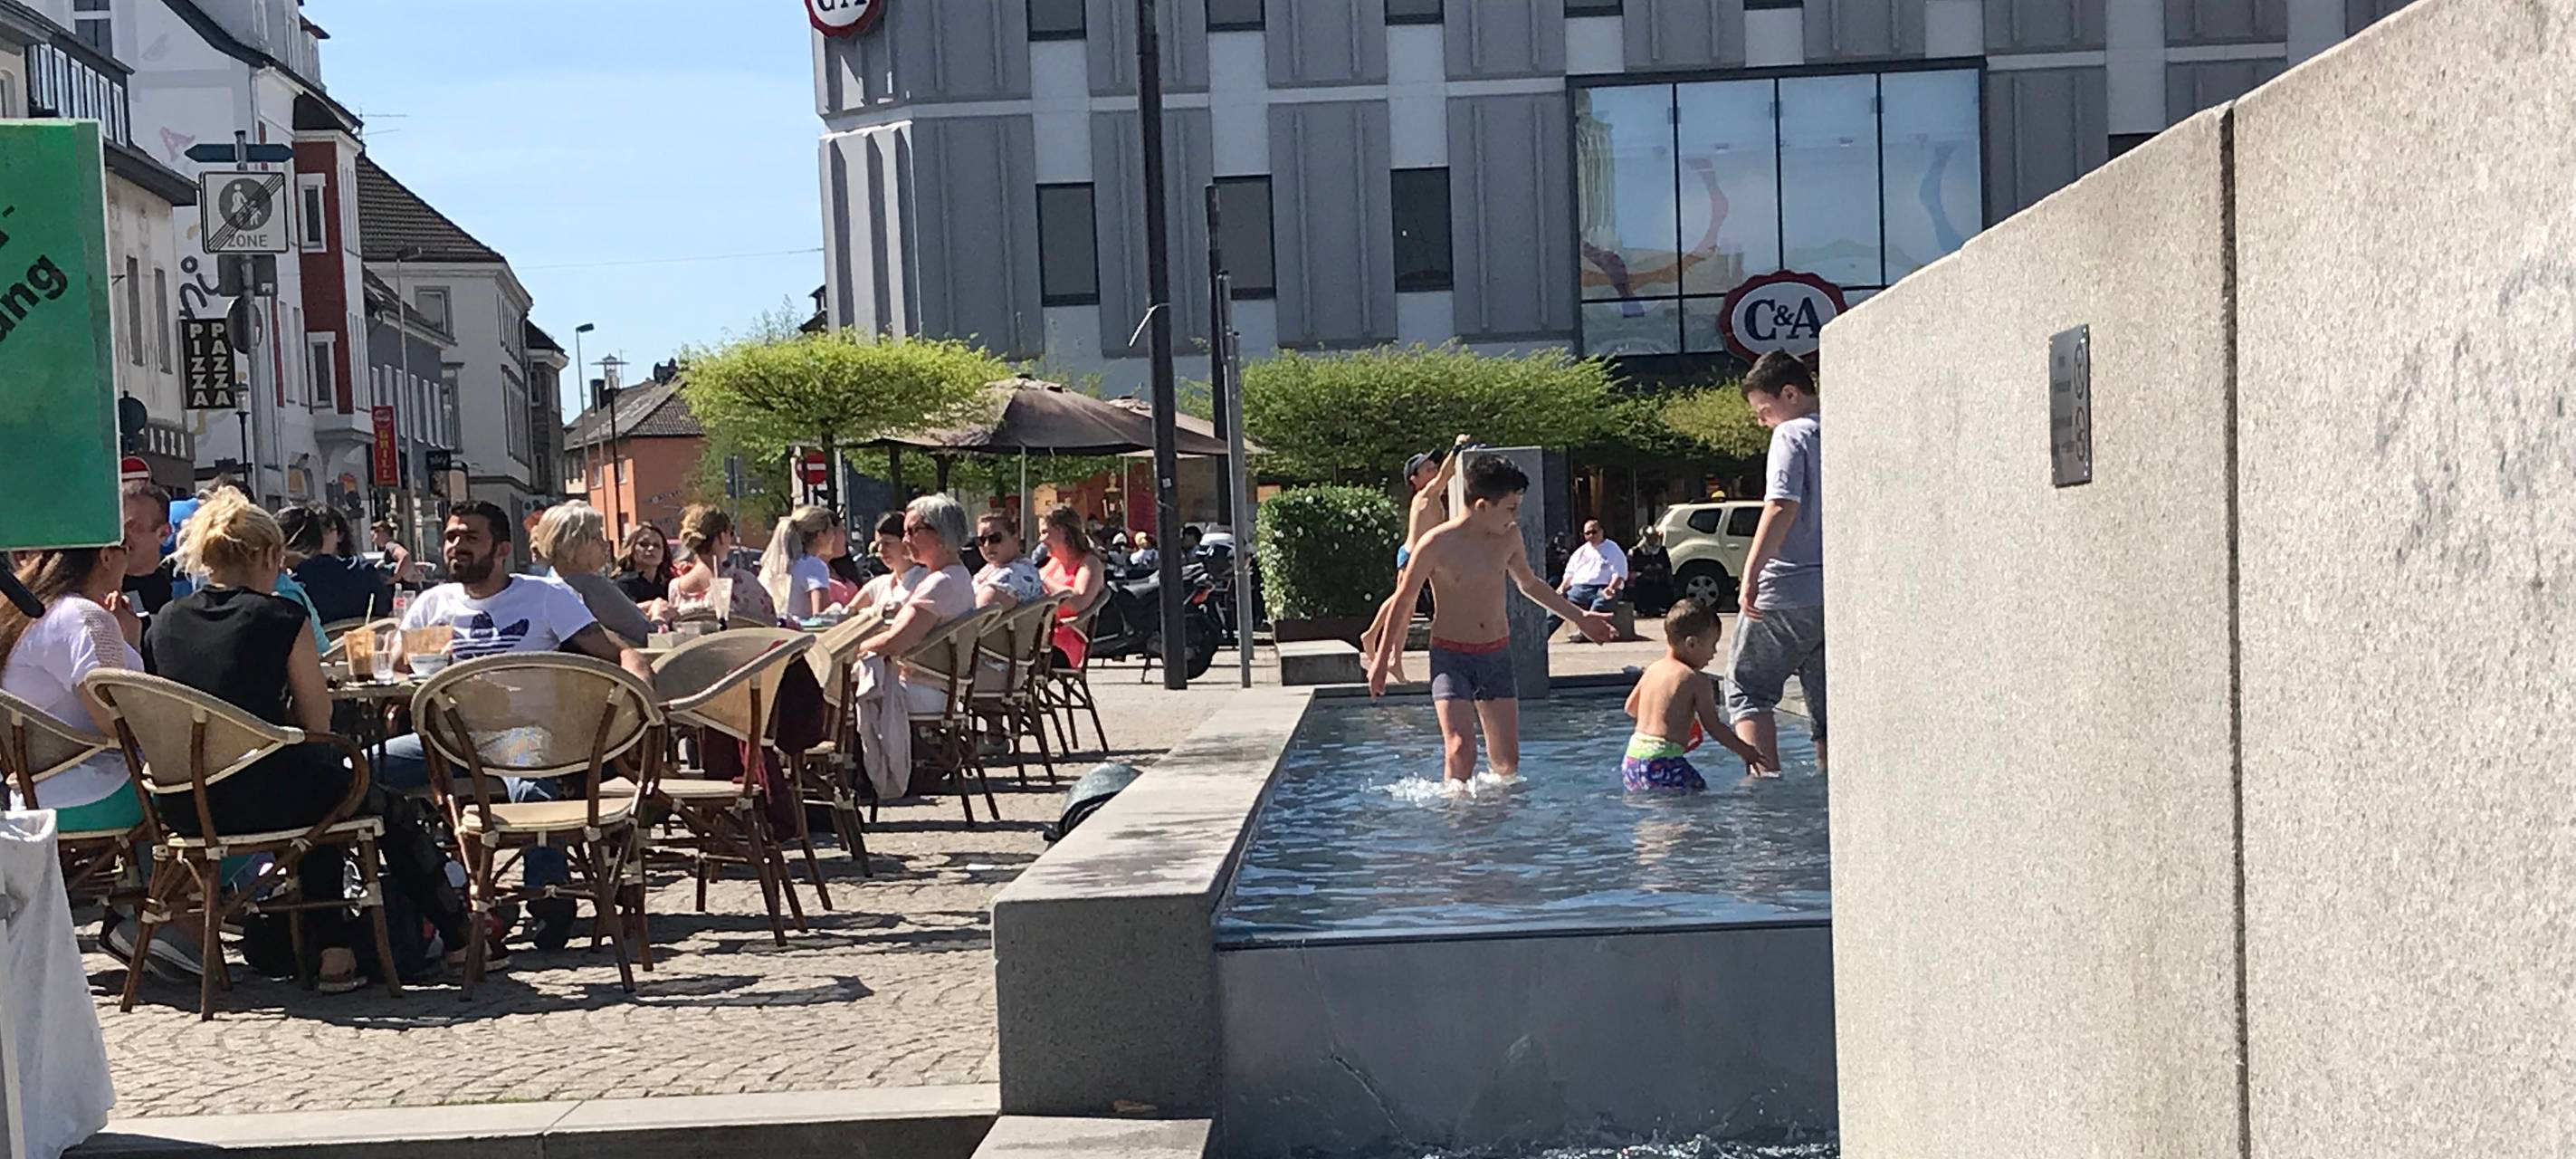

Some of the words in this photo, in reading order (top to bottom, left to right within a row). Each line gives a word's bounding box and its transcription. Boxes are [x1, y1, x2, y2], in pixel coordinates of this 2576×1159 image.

[227, 234, 269, 248] ZONE
[1743, 296, 1822, 342] C&A
[189, 322, 209, 407] PIZZA
[211, 322, 232, 407] PAZZA
[139, 426, 186, 457] AZZA
